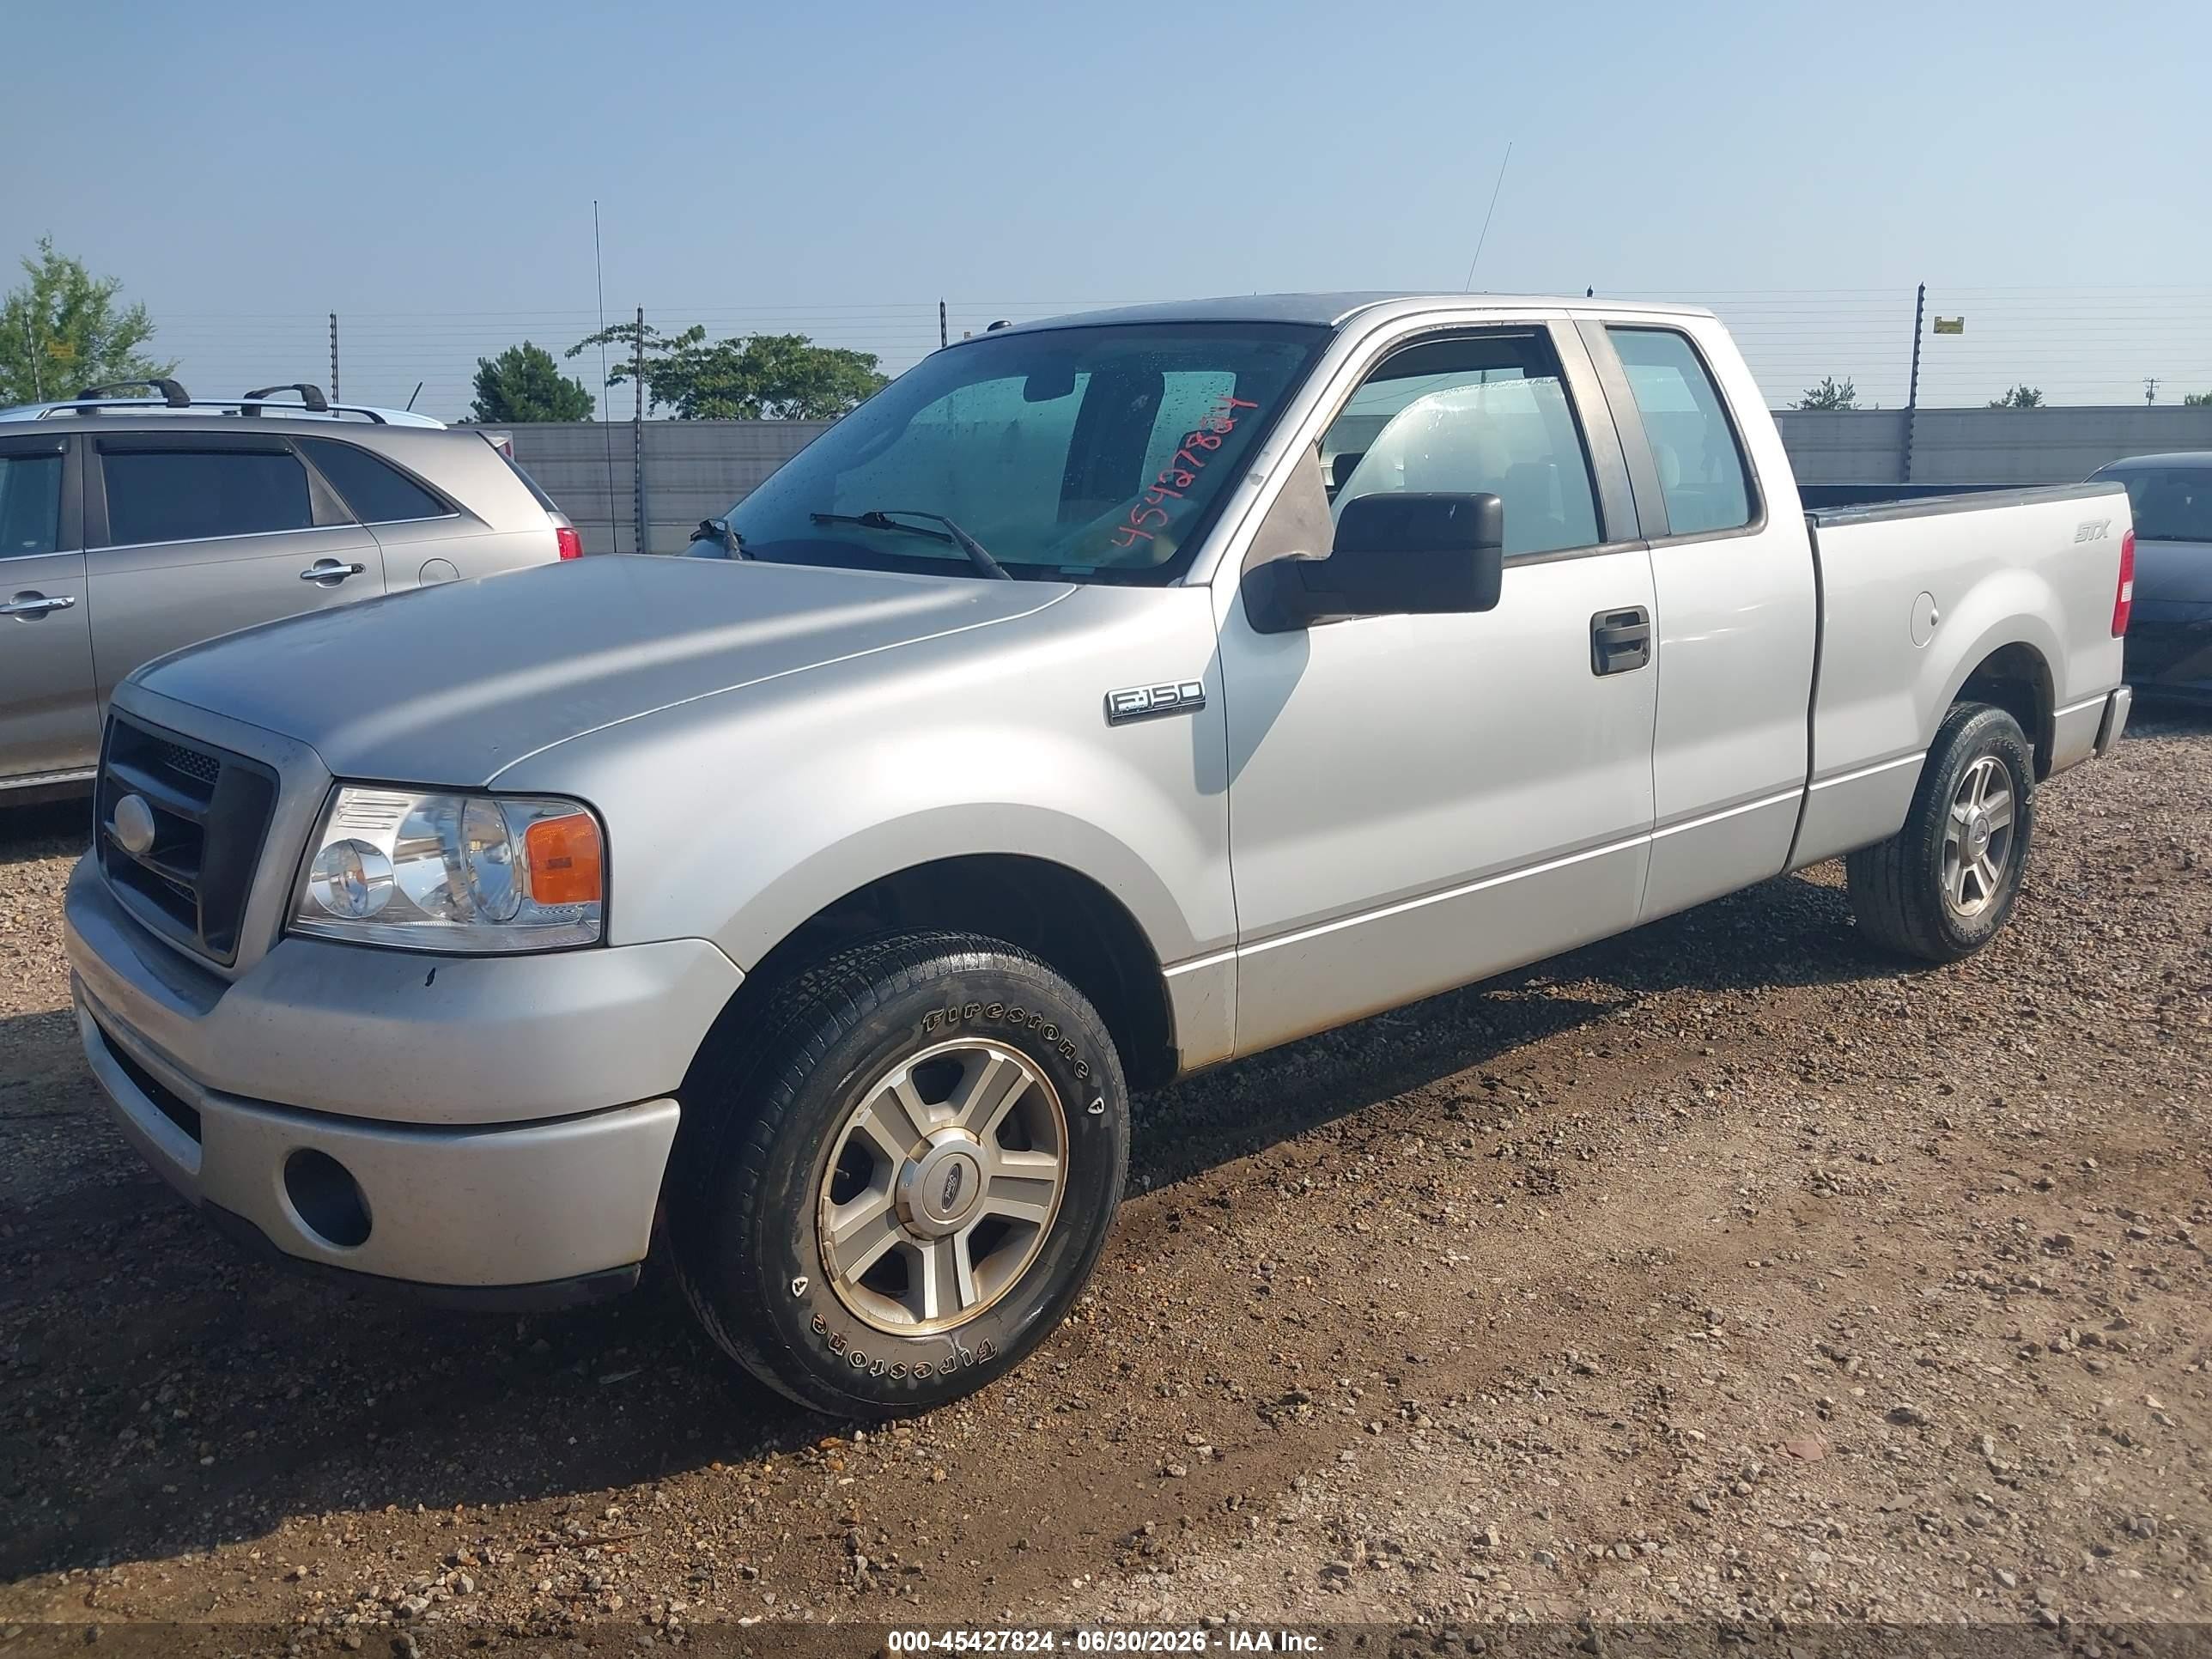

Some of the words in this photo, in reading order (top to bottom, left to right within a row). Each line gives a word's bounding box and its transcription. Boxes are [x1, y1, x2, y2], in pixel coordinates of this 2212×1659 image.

[1110, 396, 1259, 547] 45427824
[2074, 520, 2112, 544] STX
[1109, 679, 1206, 714] F-150
[921, 1001, 1091, 1080] Firestone
[811, 1313, 998, 1380] Firestone
